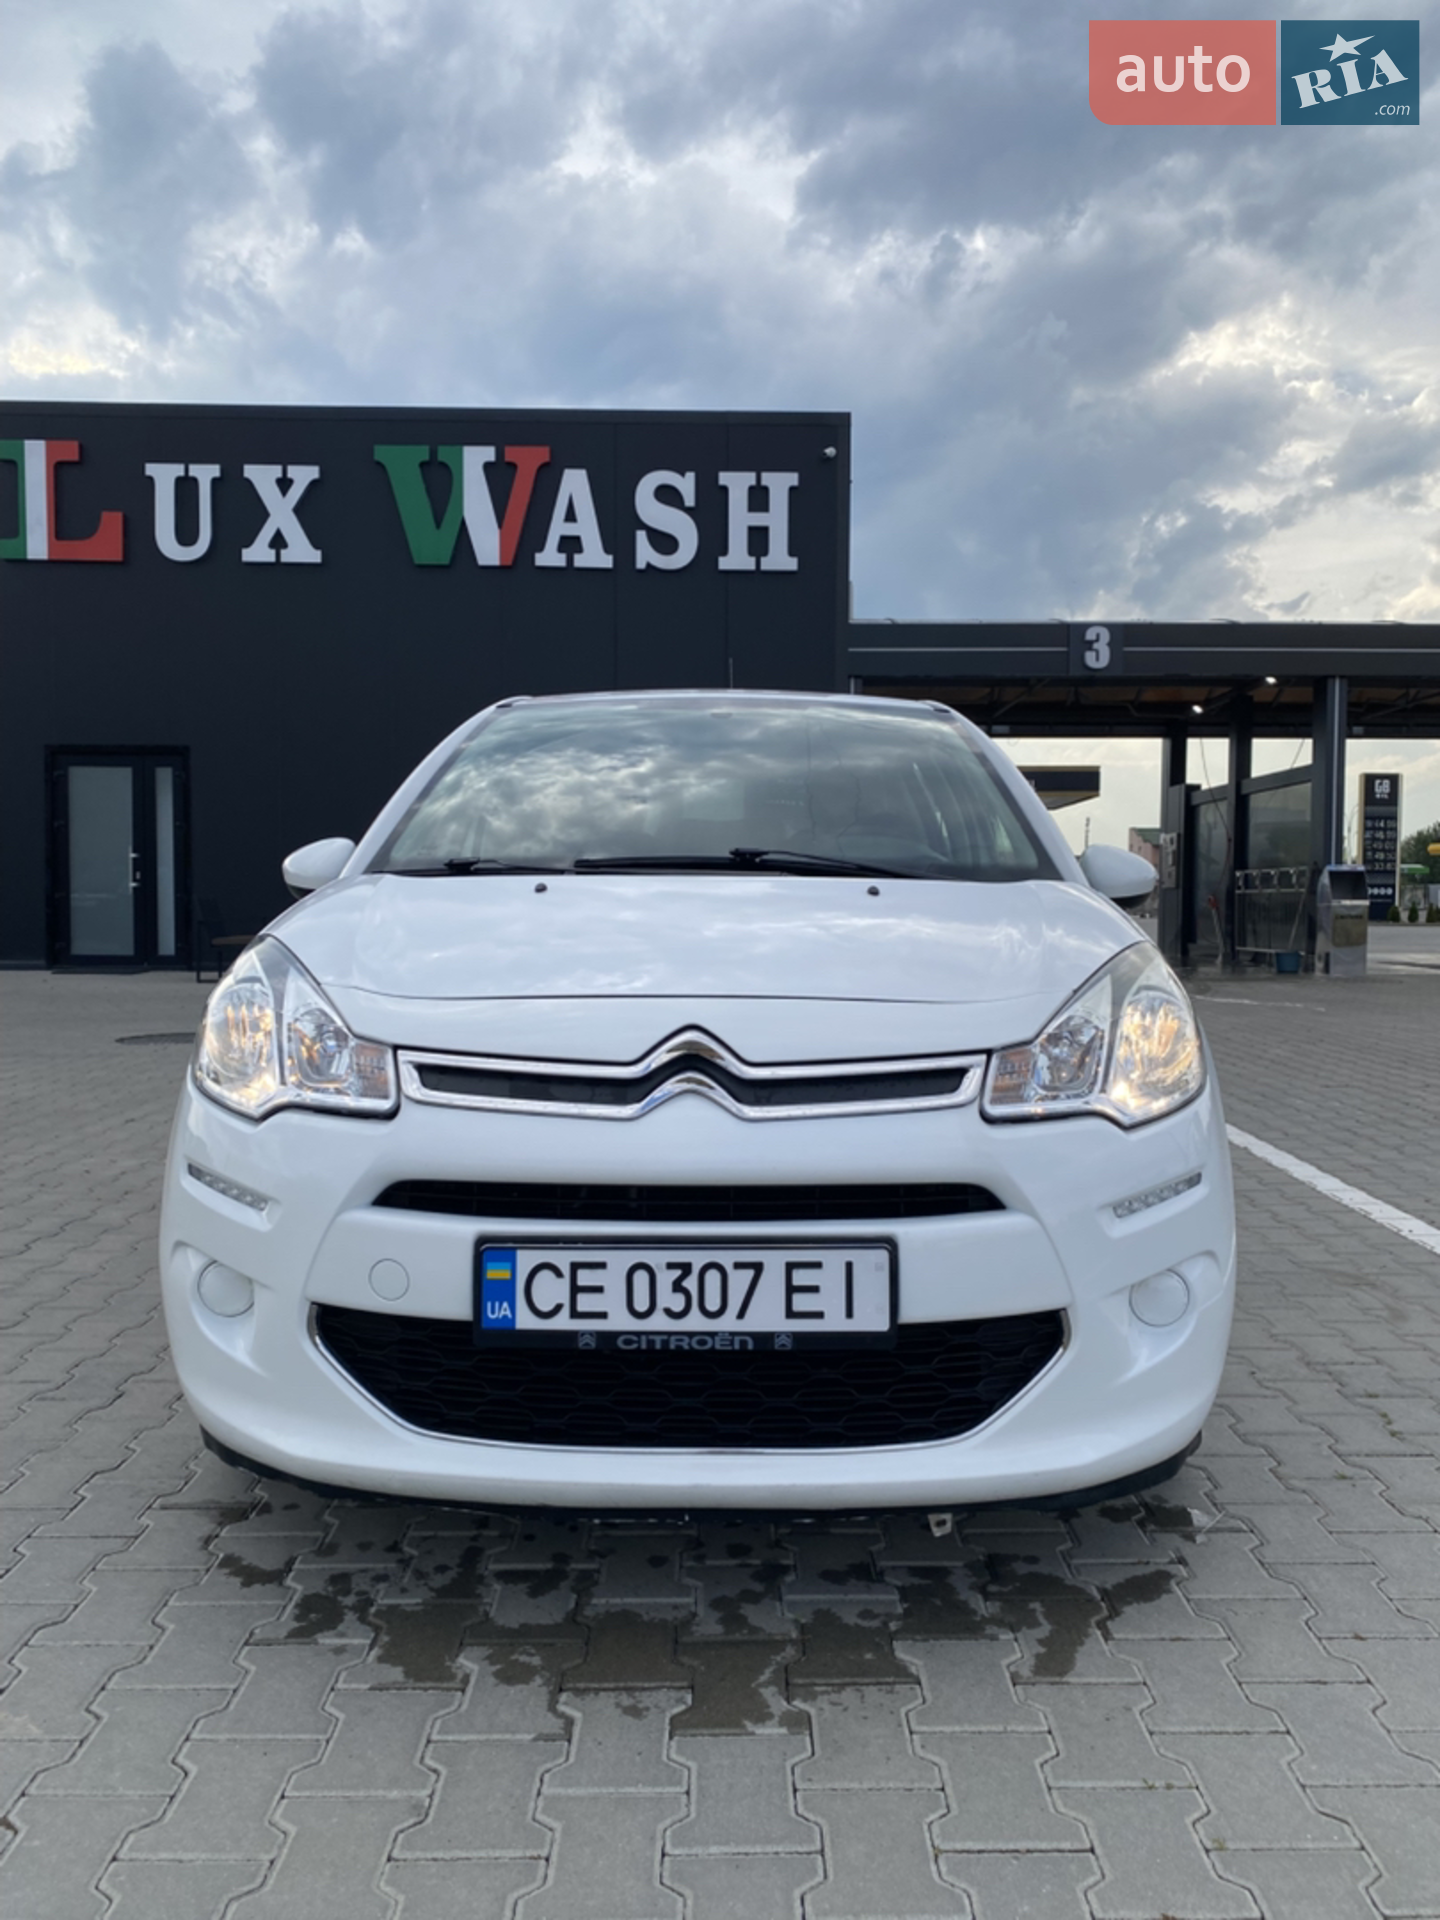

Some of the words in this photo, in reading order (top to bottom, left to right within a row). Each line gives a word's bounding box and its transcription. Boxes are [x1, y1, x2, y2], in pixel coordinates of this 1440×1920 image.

[373, 445, 799, 571] WASH
[1084, 625, 1110, 669] 3
[487, 1302, 512, 1319] UA
[524, 1261, 608, 1320] CE
[625, 1261, 764, 1320] 0307
[785, 1261, 854, 1320] EI
